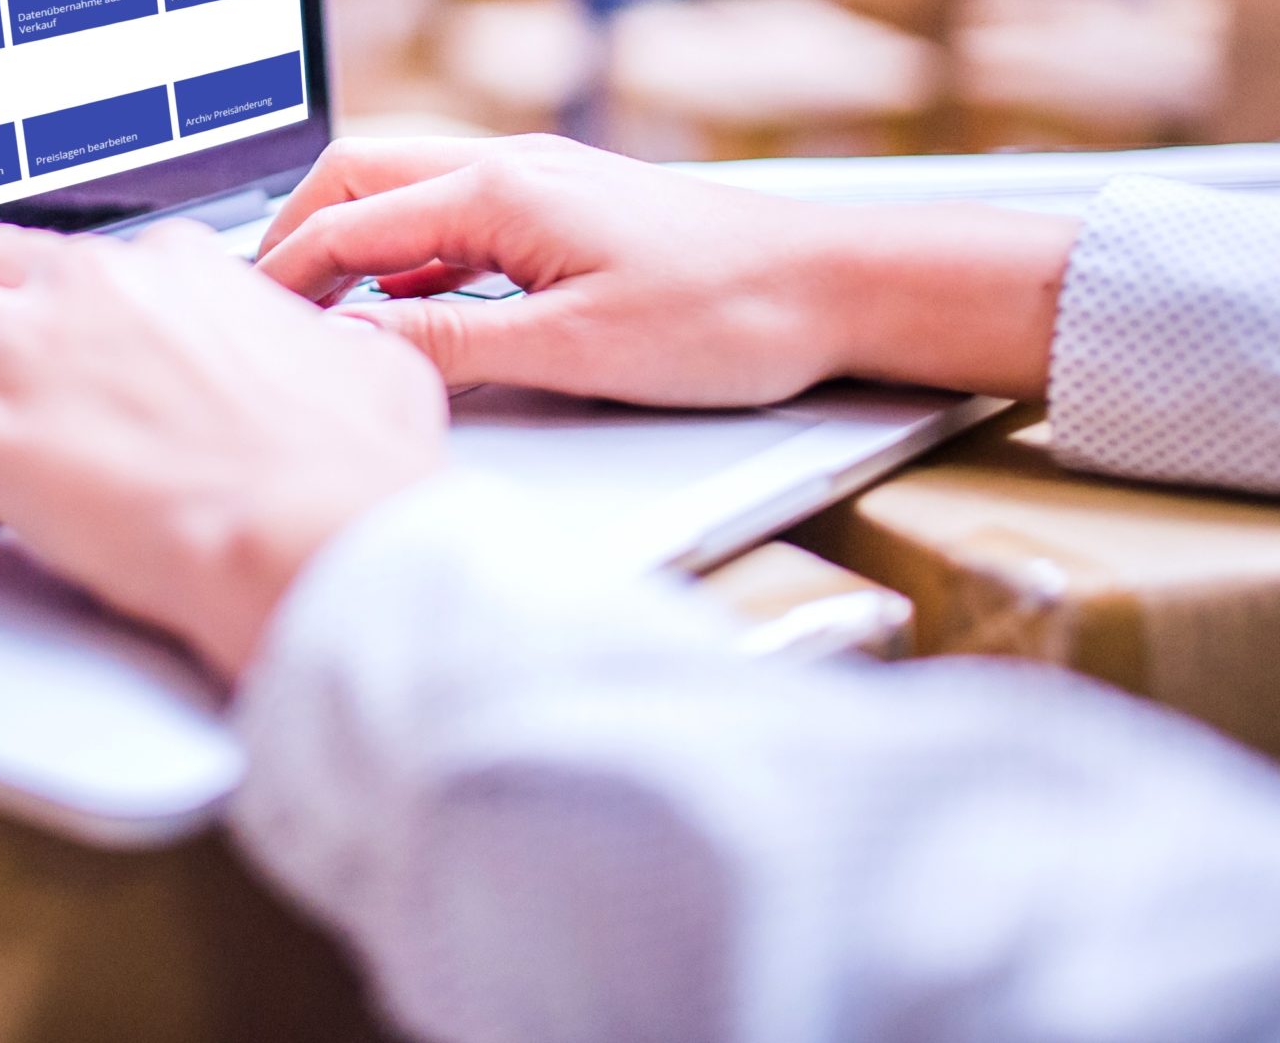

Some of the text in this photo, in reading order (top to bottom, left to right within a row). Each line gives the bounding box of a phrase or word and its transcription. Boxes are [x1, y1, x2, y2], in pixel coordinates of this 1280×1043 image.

[19, 18, 56, 34] Verkauf
[186, 97, 273, 126] Archiv Preisänderung
[36, 134, 138, 166] Preislagen bearbeiten
